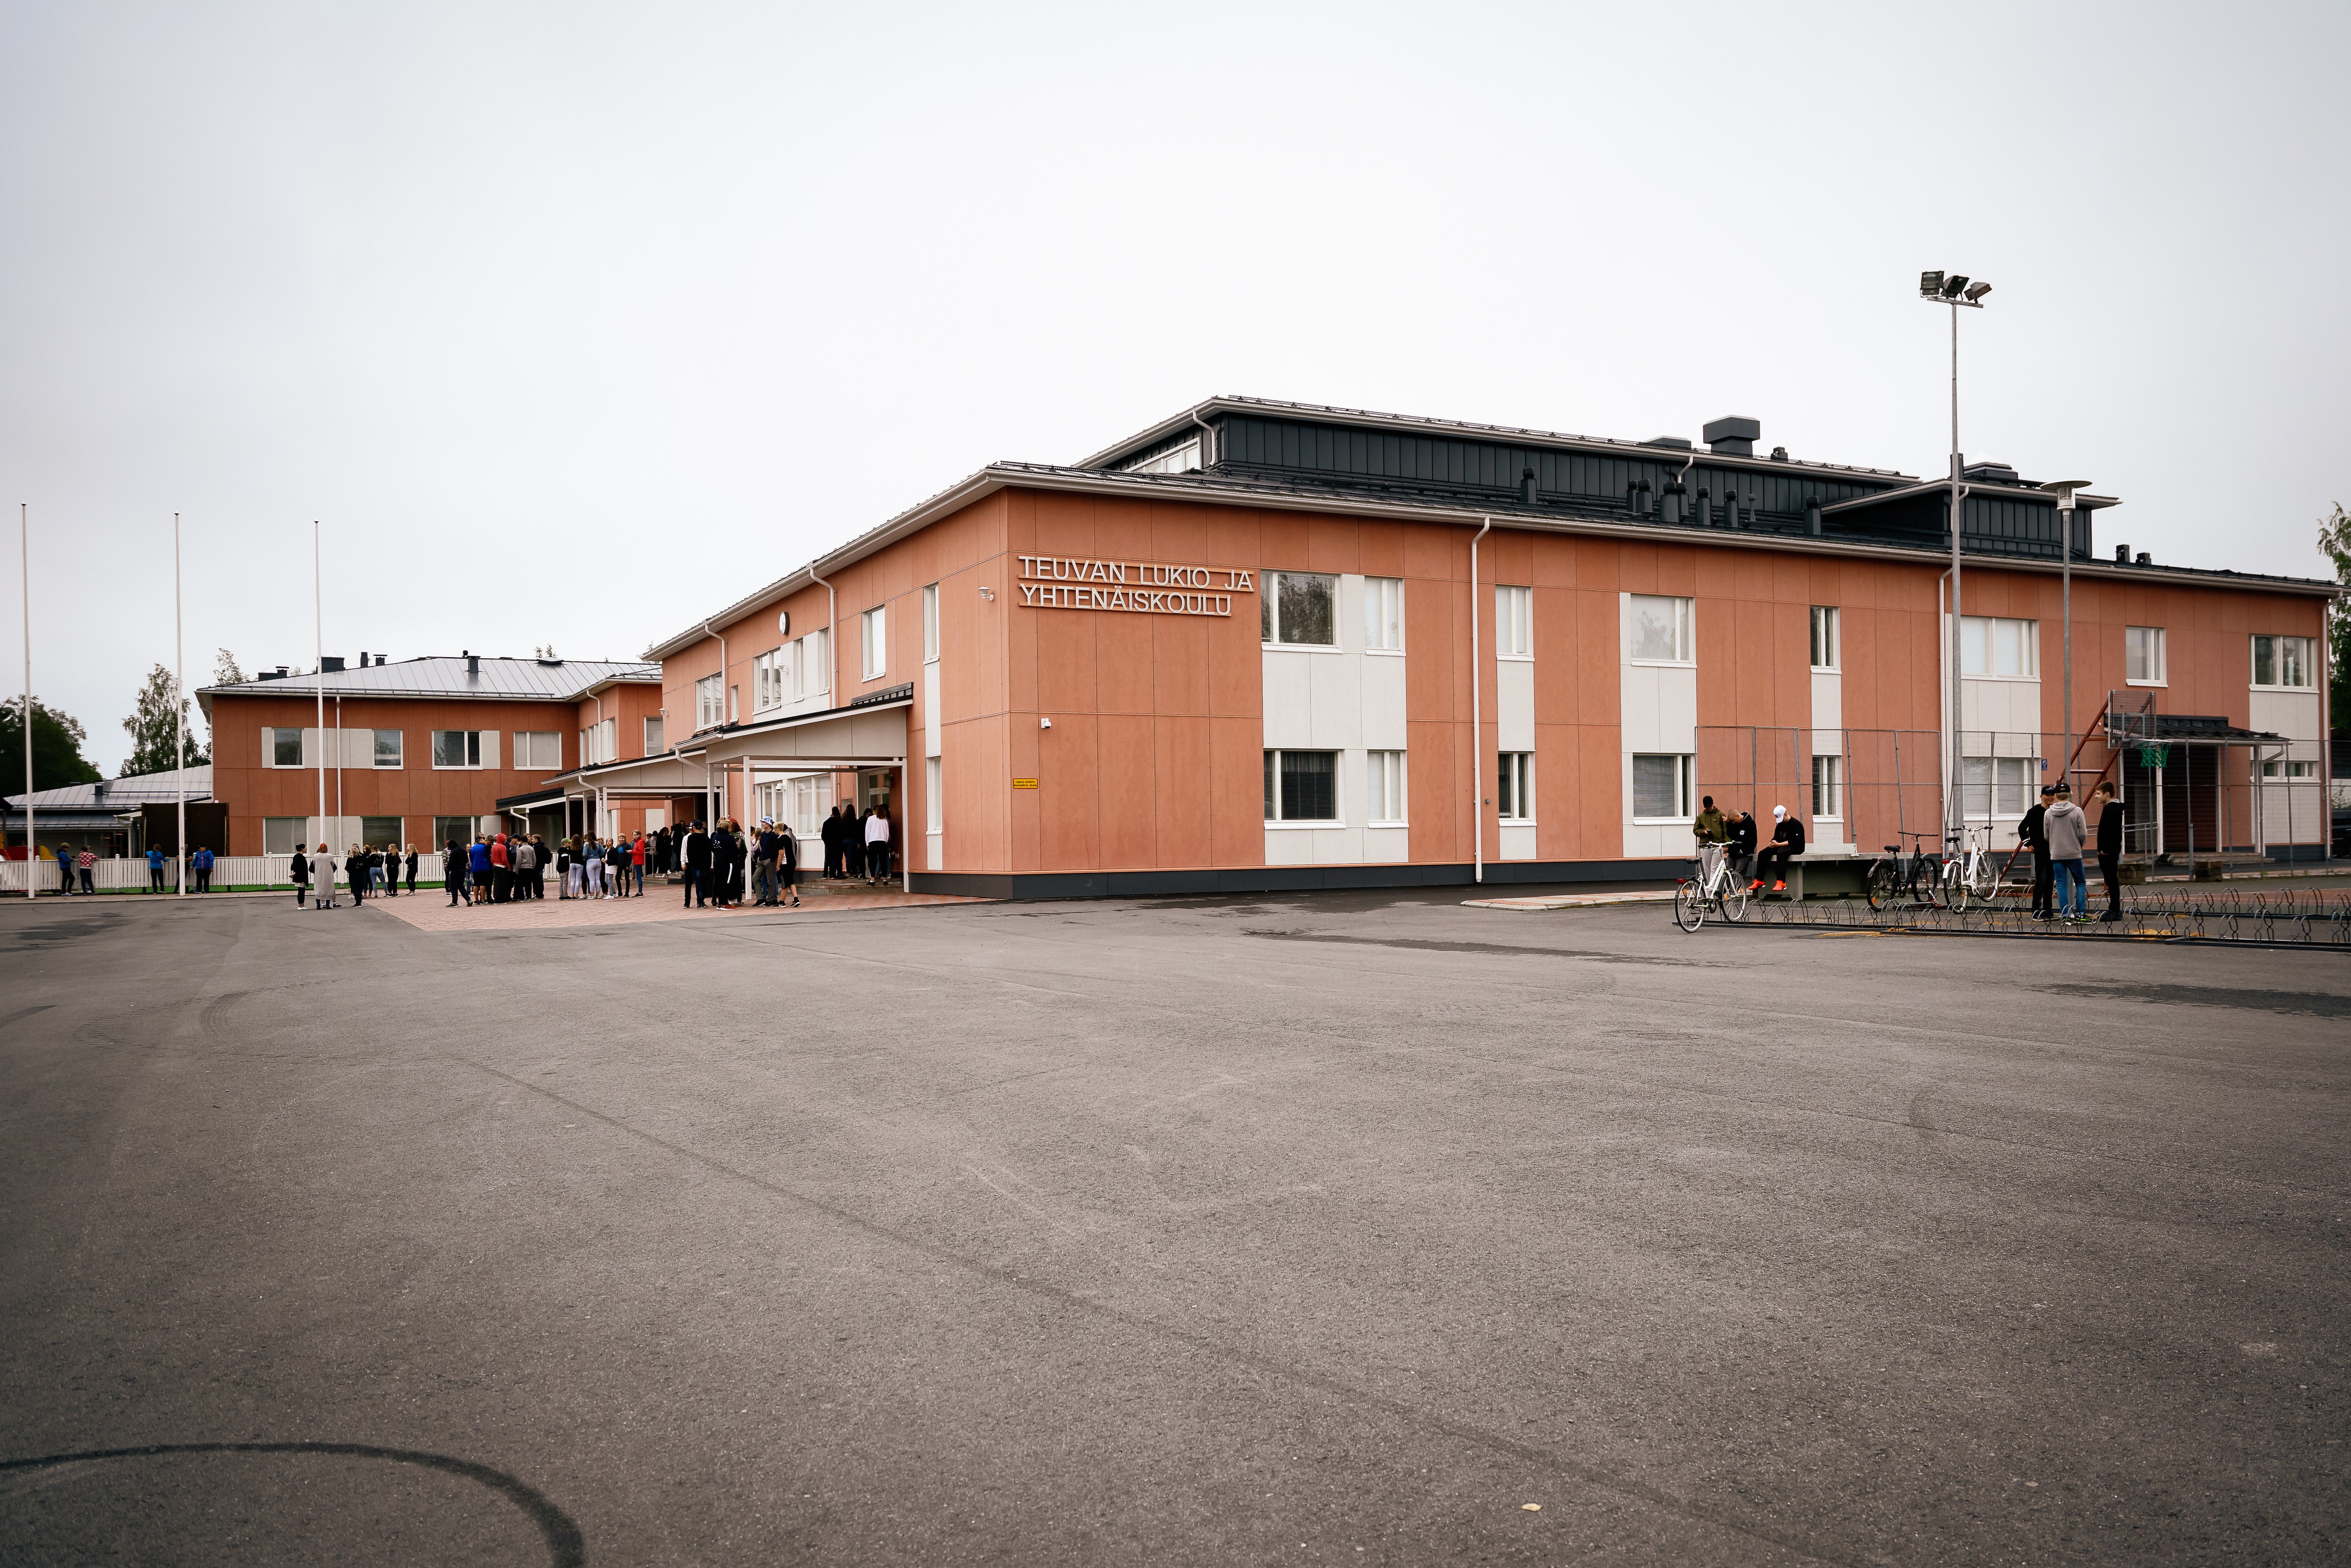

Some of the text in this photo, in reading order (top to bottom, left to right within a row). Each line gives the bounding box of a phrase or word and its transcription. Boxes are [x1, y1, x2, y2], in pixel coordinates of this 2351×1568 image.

[1019, 555, 1254, 591] TEUVAN LUKIO JA
[1019, 582, 1231, 616] YHTENÄISKOULU
